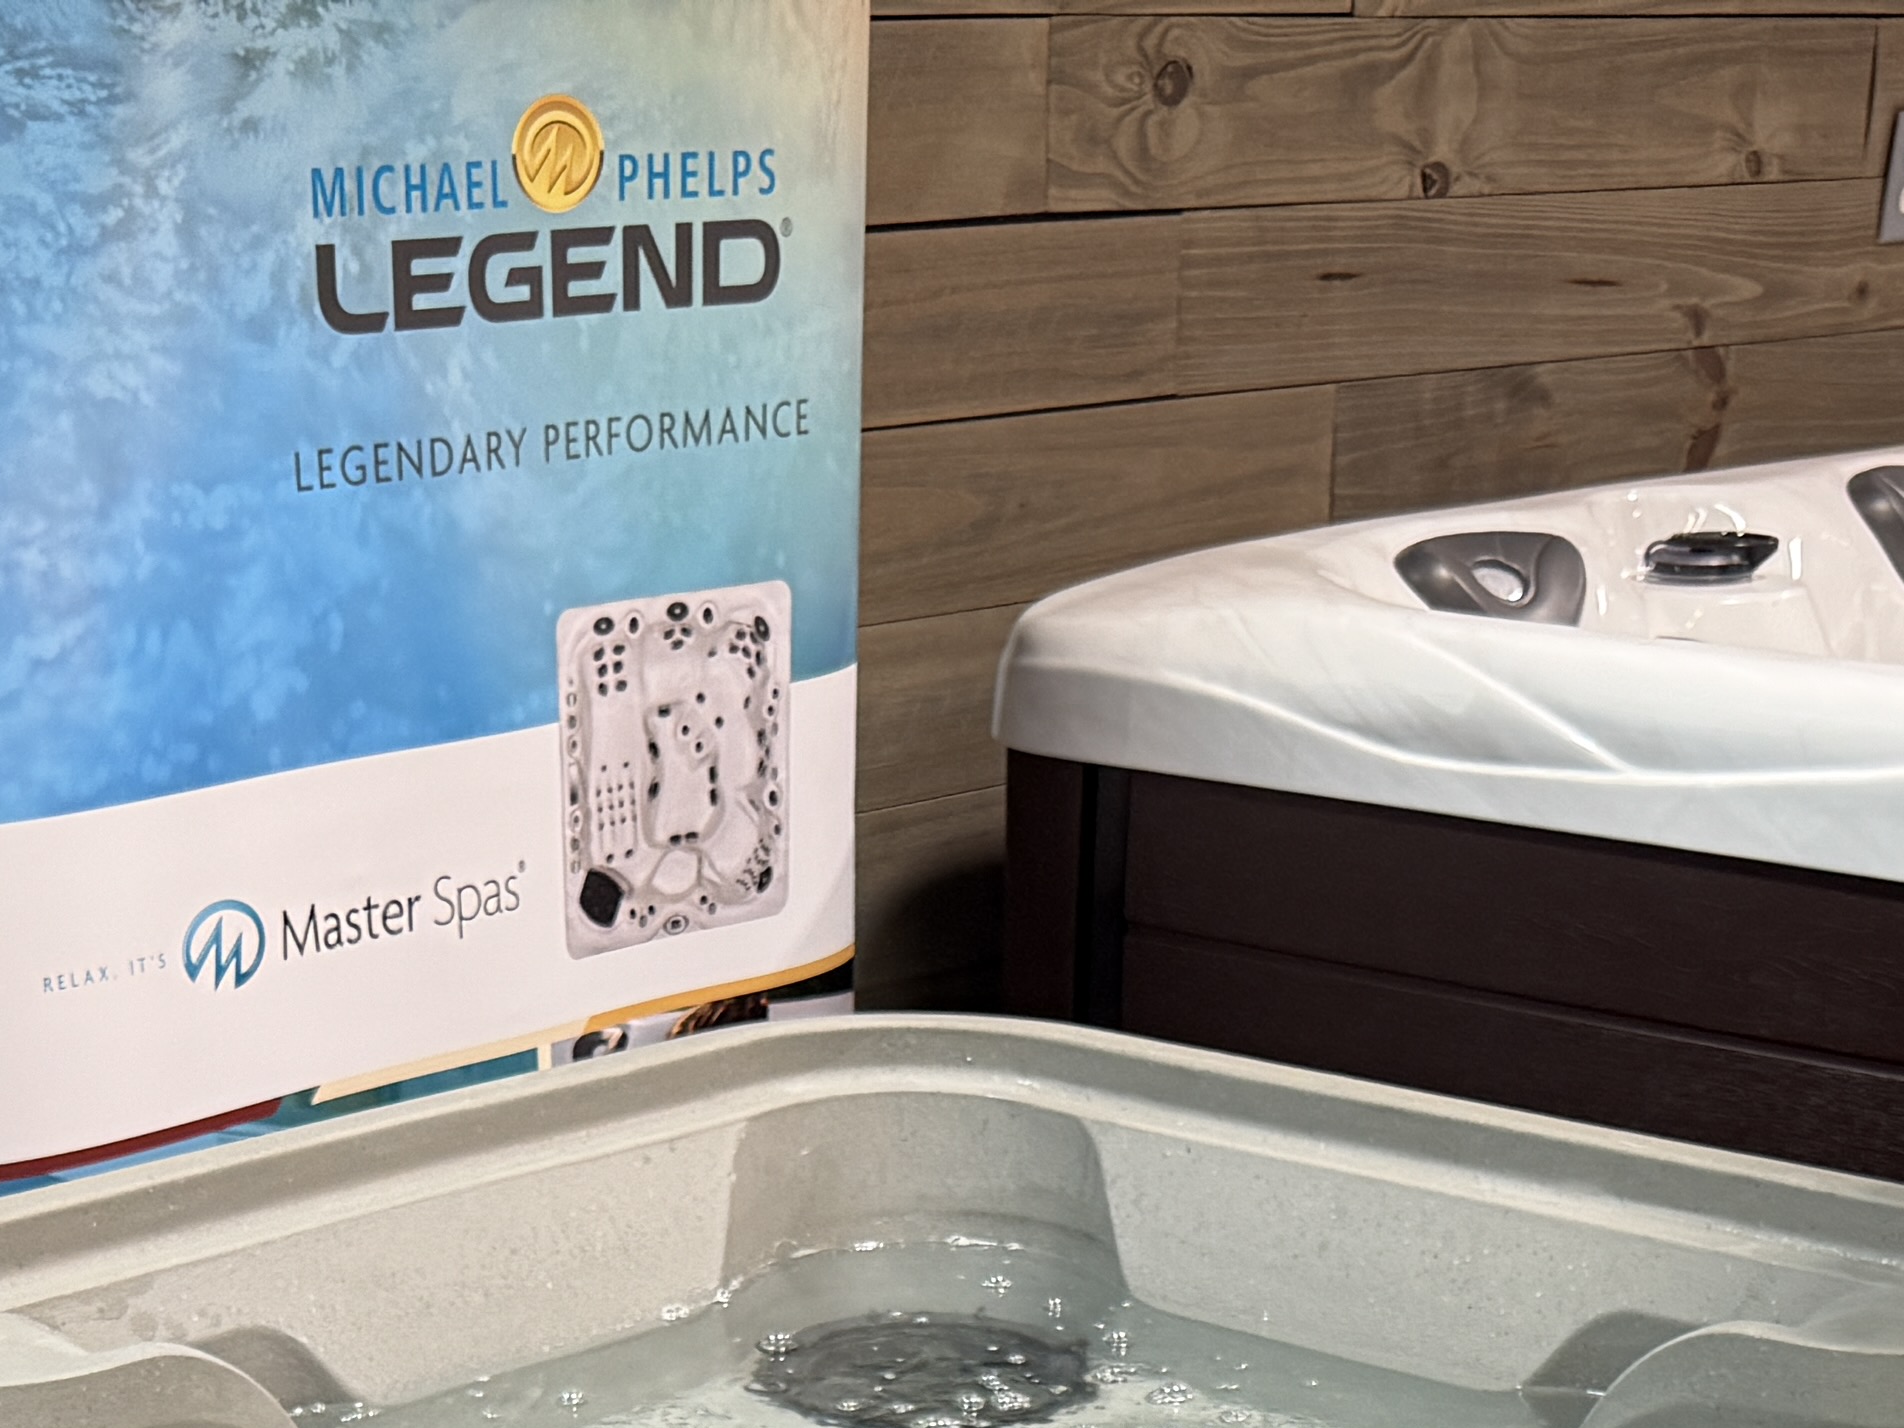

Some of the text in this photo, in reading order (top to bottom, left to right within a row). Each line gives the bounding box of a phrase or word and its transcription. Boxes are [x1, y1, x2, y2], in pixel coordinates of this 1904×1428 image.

[310, 148, 777, 219] MICHAEL PHELPS
[315, 218, 782, 336] LEGEND
[294, 399, 810, 493] LEGENDARY PERFORMANCE
[282, 875, 521, 961] Master Spas
[129, 954, 167, 977] IT'S
